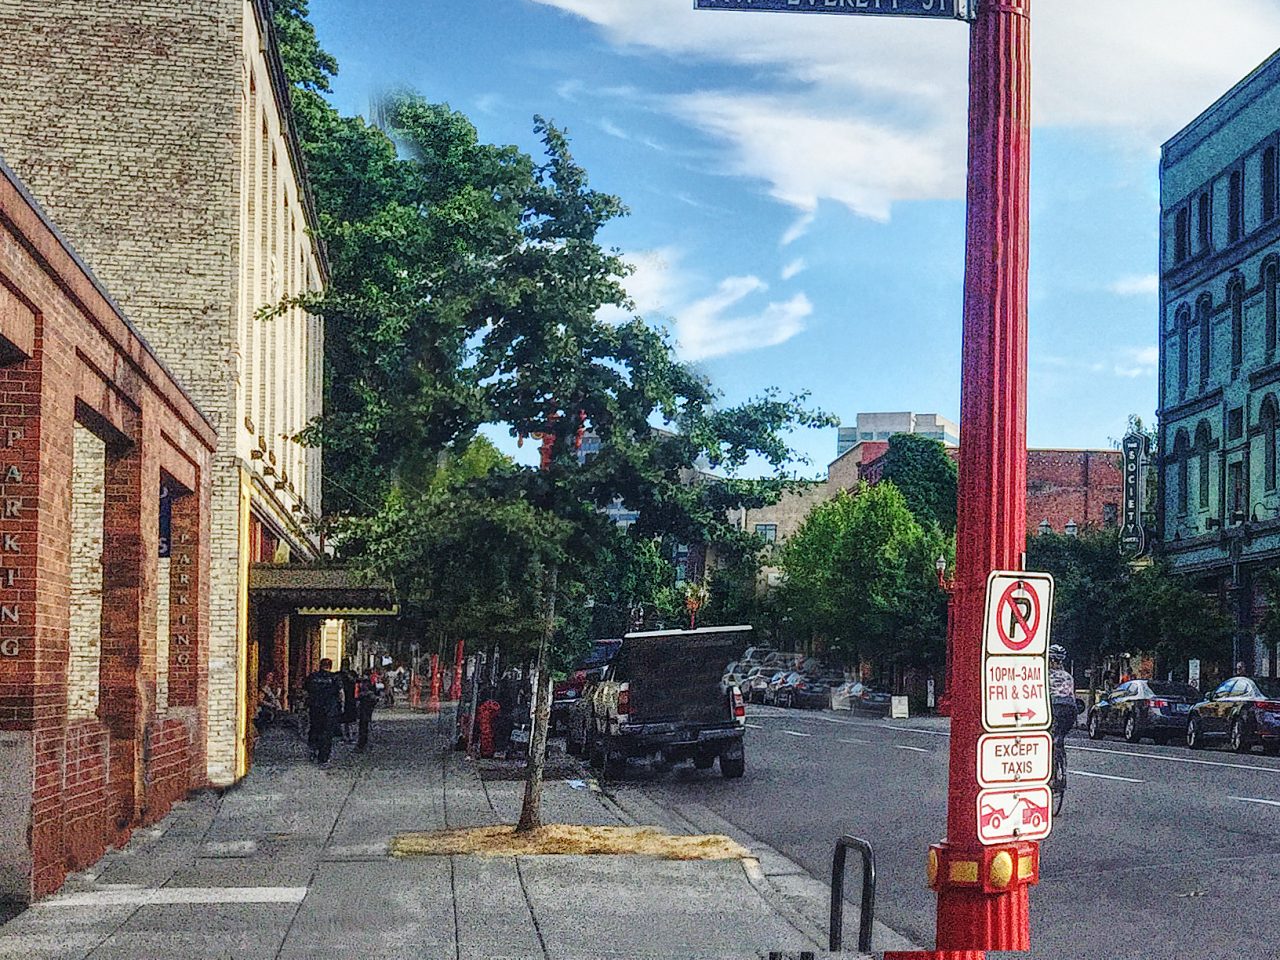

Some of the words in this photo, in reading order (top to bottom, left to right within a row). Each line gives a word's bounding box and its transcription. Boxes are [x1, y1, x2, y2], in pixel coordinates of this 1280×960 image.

[1127, 450, 1136, 533] SOCIETY
[1, 425, 25, 657] PARKING
[177, 533, 191, 666] PARKING
[989, 666, 1041, 682] 10PM-3AM
[988, 684, 1008, 701] FRI
[1011, 684, 1019, 700] &
[1023, 683, 1043, 700] SAT
[994, 742, 1039, 758] EXCEPT
[1001, 760, 1033, 775] TAXIS
